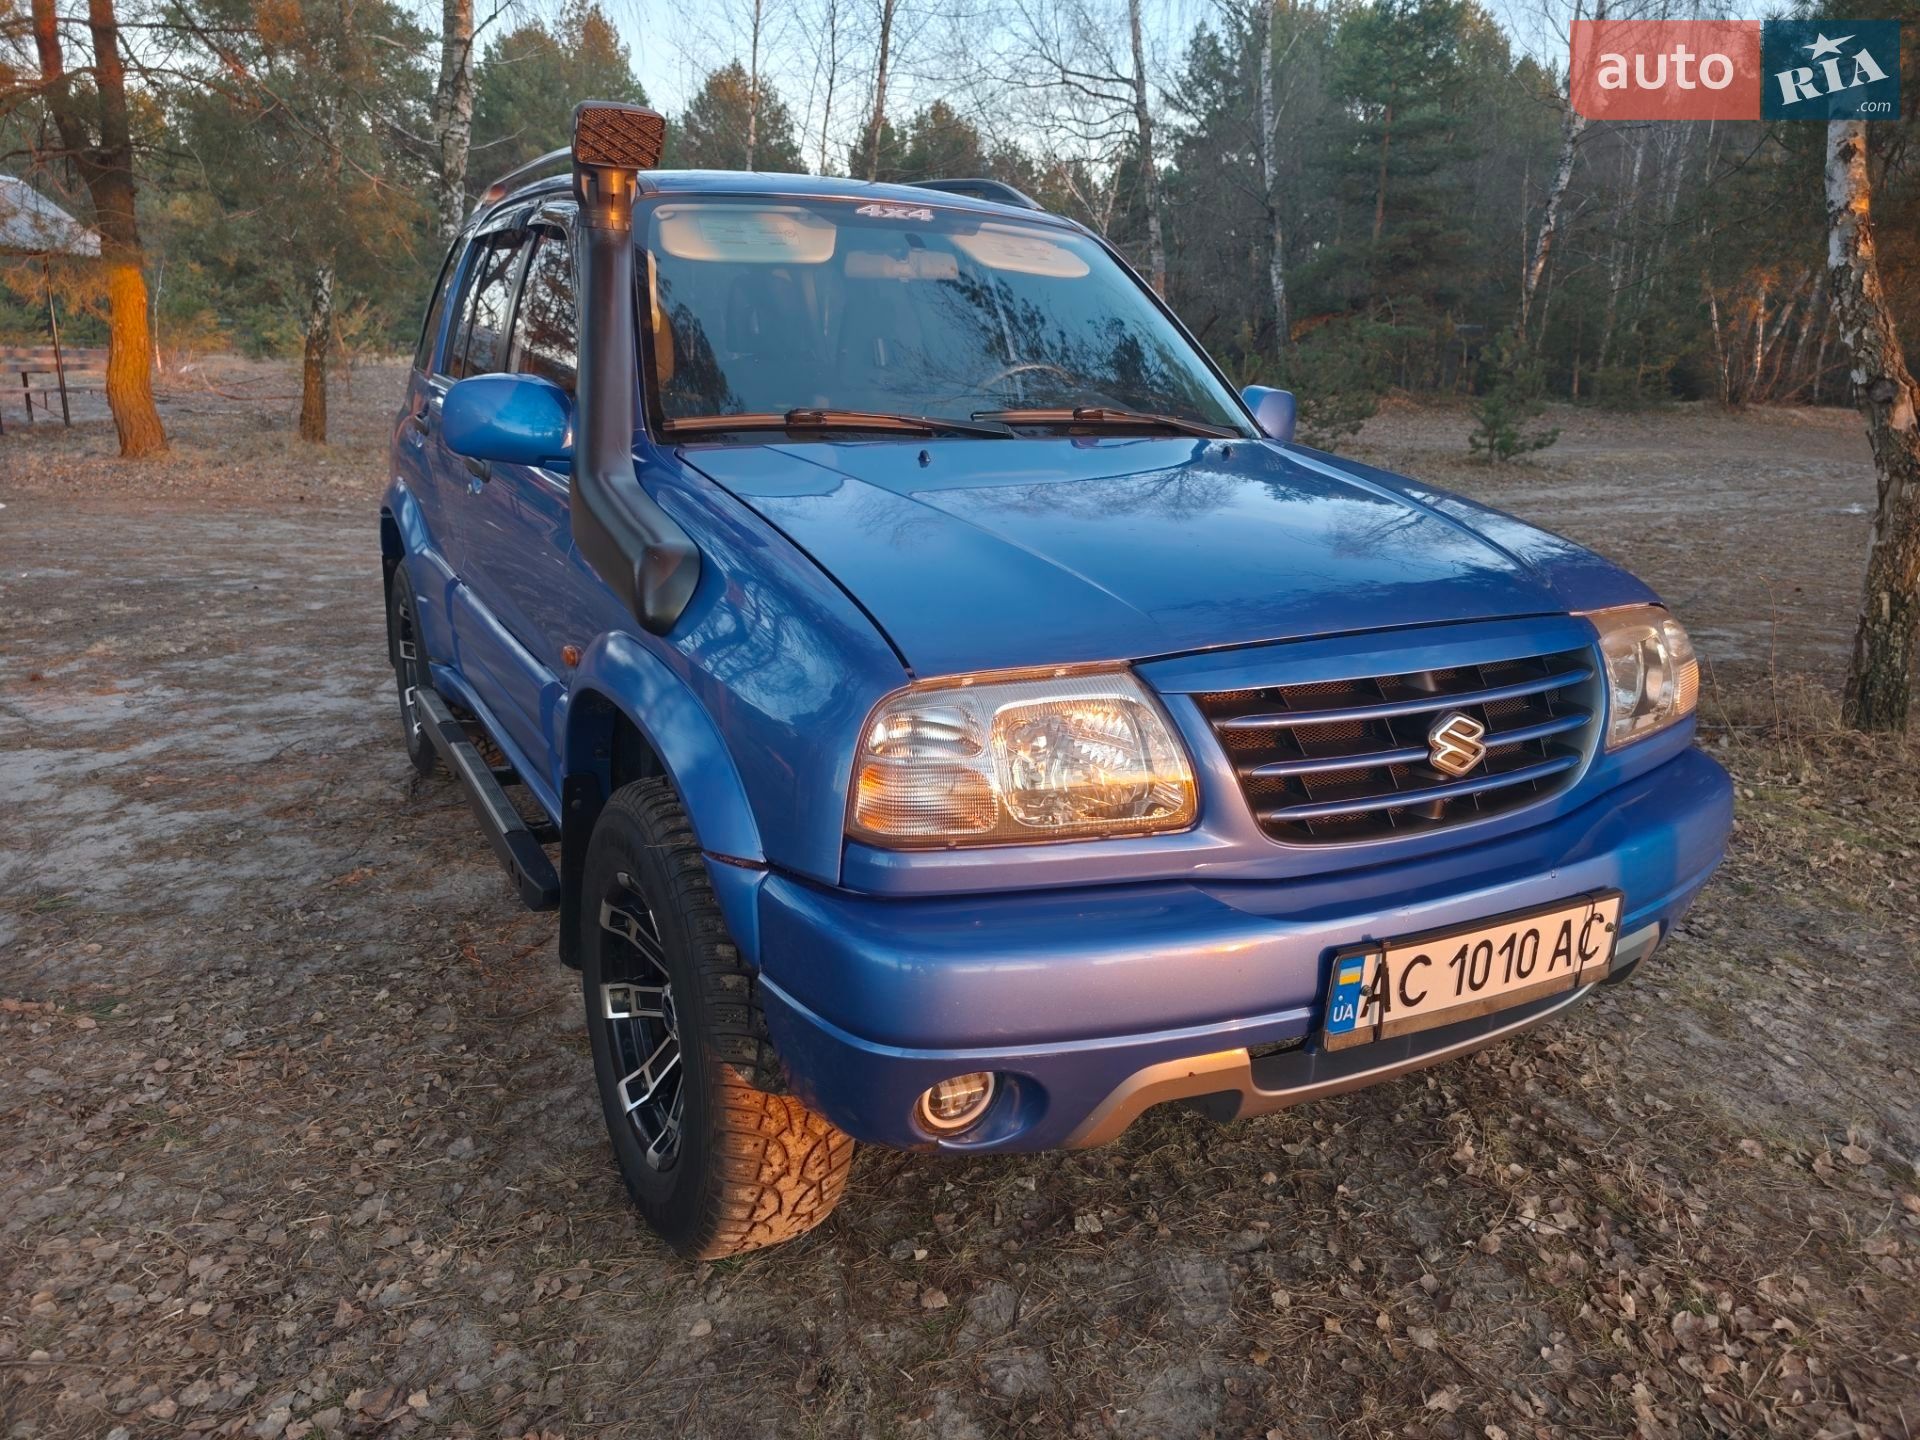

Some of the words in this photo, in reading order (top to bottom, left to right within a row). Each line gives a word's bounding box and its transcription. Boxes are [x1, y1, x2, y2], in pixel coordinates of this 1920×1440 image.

[1359, 954, 1432, 1019] AC
[1449, 928, 1540, 997] 1010
[1547, 912, 1605, 973] AC
[1333, 1003, 1355, 1023] UA
